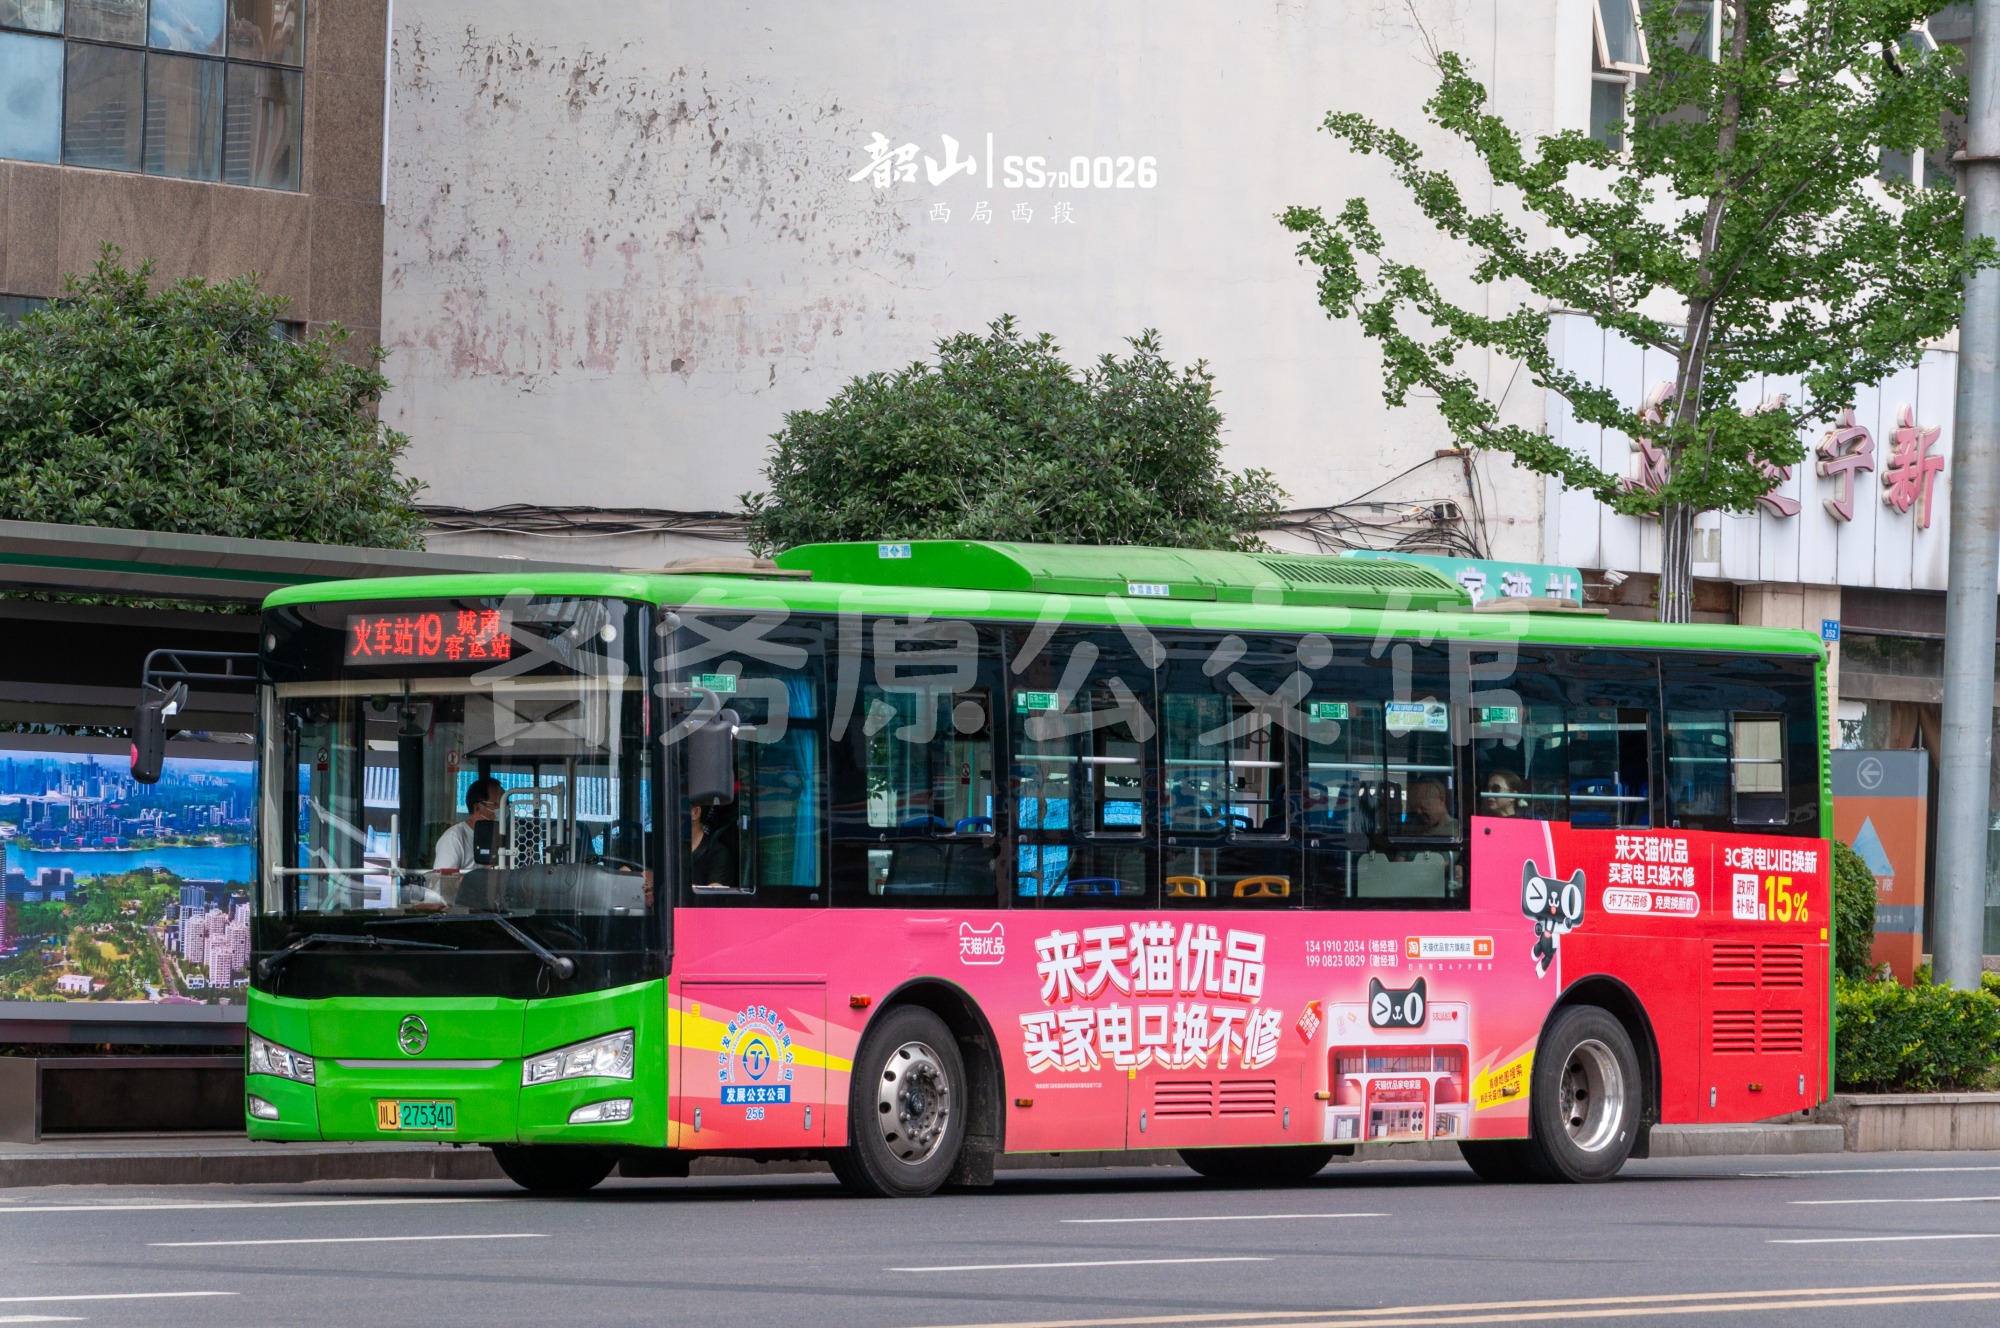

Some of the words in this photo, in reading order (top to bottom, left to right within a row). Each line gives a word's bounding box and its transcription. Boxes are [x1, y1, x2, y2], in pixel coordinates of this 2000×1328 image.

[457, 610, 501, 636] 城南
[352, 617, 414, 656] 火车站
[414, 613, 442, 656] 19
[445, 632, 511, 660] 客运站
[1615, 835, 1689, 864] 来天猫优品
[1724, 847, 1818, 874] 3C家电以旧换新
[1608, 862, 1695, 888] 买家电只换不修
[1736, 878, 1756, 896] 政府
[1609, 893, 1648, 908] 坏了不用修
[1655, 895, 1694, 911] 免费换新机
[1736, 897, 1756, 916] 补贴
[1765, 875, 1808, 922] 15%
[959, 936, 1005, 956] 天猫优品
[1305, 940, 1321, 953] 134
[1322, 940, 1342, 953] 1910
[1343, 940, 1365, 953] 2034
[1408, 941, 1419, 955] 淘
[1422, 942, 1472, 953] 天猫优品官方旗舰店
[1034, 921, 1267, 1004] 来天猫优品
[1306, 955, 1321, 968] 199
[1321, 955, 1342, 968] 0823
[1344, 955, 1366, 968] 0829
[1019, 1003, 1284, 1074] 买家电只换不修
[726, 1088, 786, 1102] 发展公交公司
[380, 1105, 396, 1125] 川J
[404, 1105, 453, 1125] 27534D
[746, 1108, 764, 1119] 256
